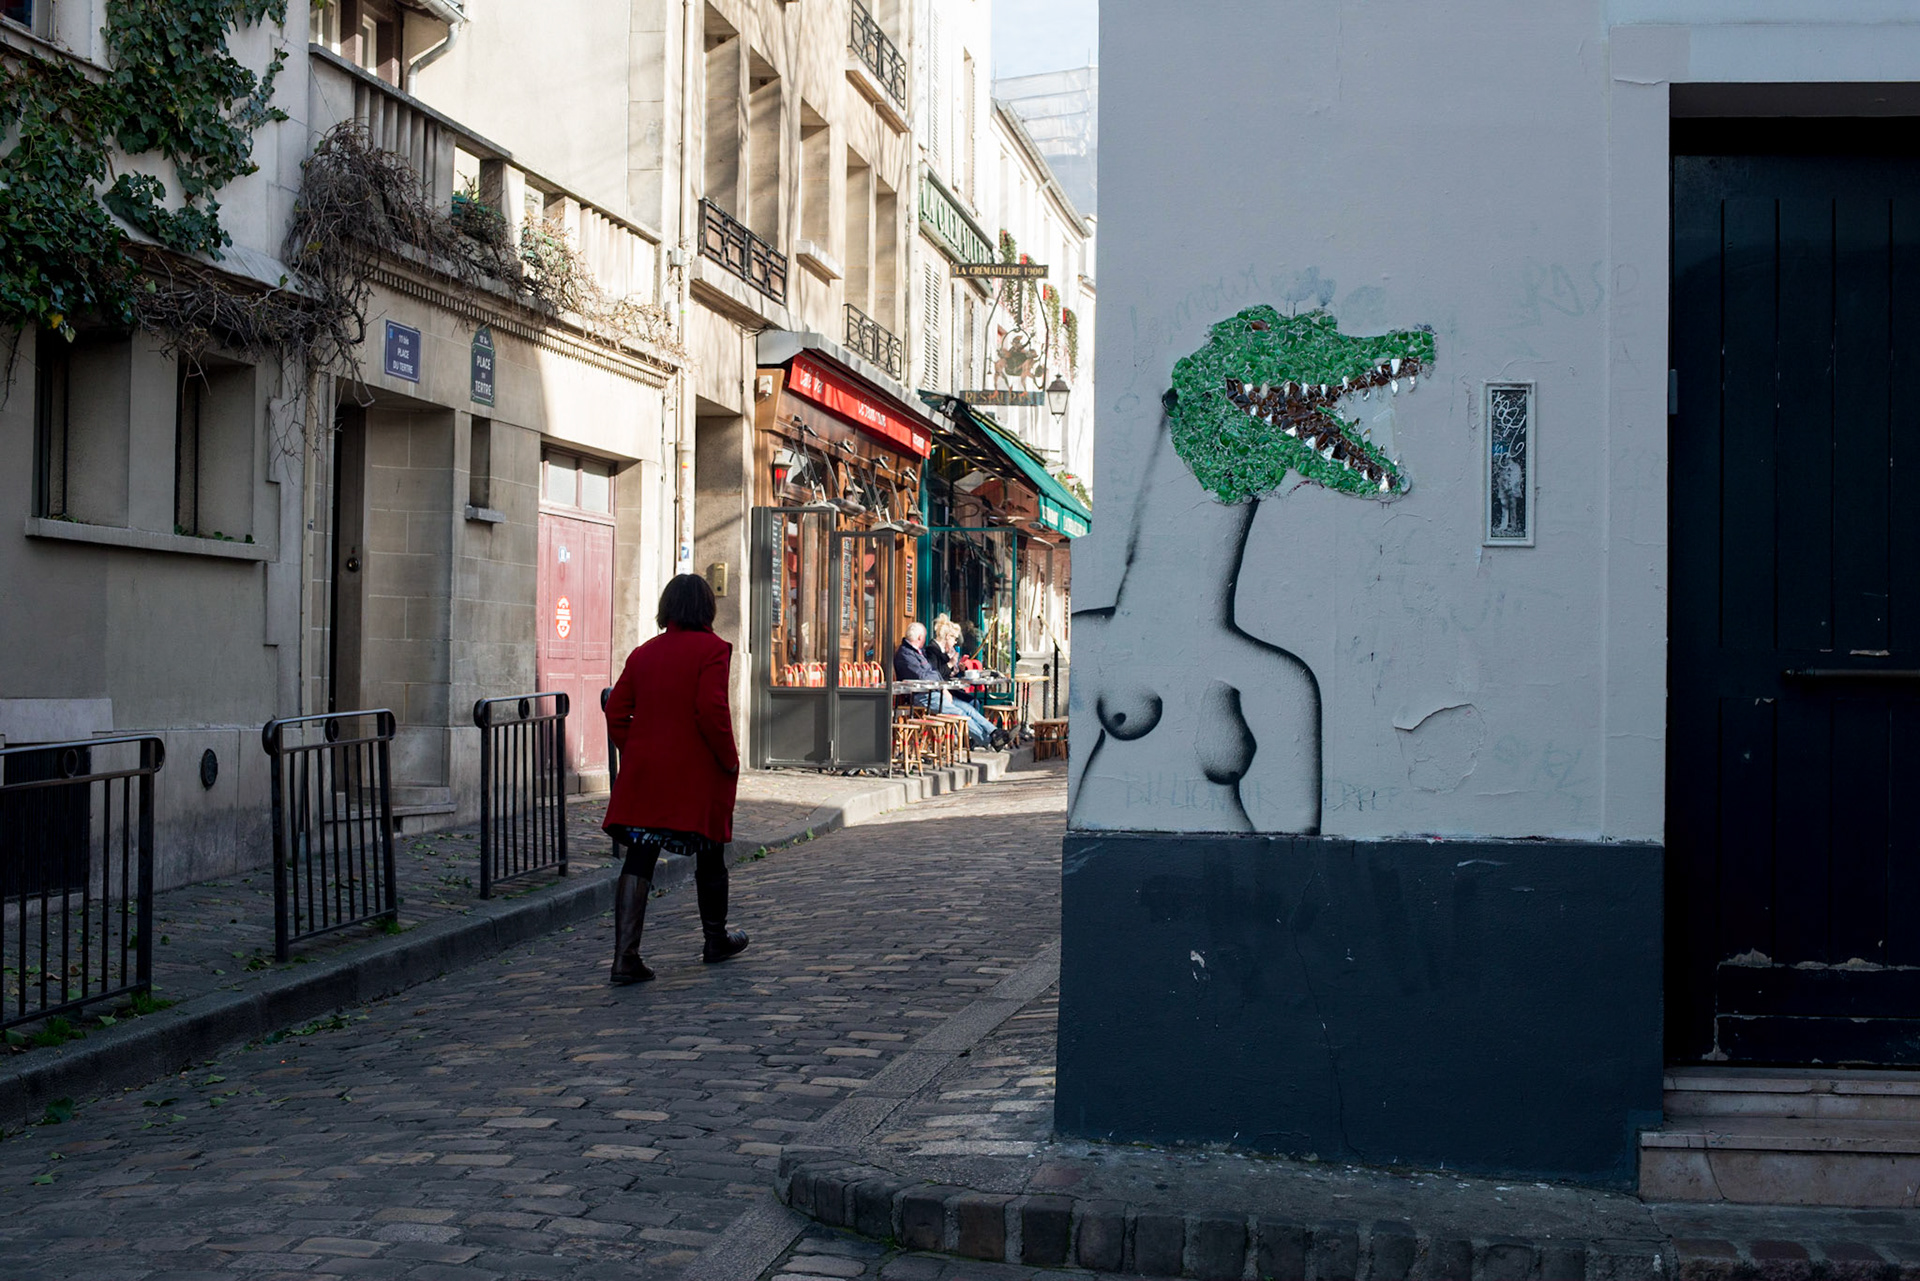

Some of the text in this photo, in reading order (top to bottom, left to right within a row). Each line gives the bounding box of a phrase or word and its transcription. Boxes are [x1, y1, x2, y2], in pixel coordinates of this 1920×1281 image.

[397, 348, 410, 359] PLACE
[399, 362, 413, 374] TERTRE
[476, 355, 491, 370] PLACE
[475, 380, 492, 396] TERTRE
